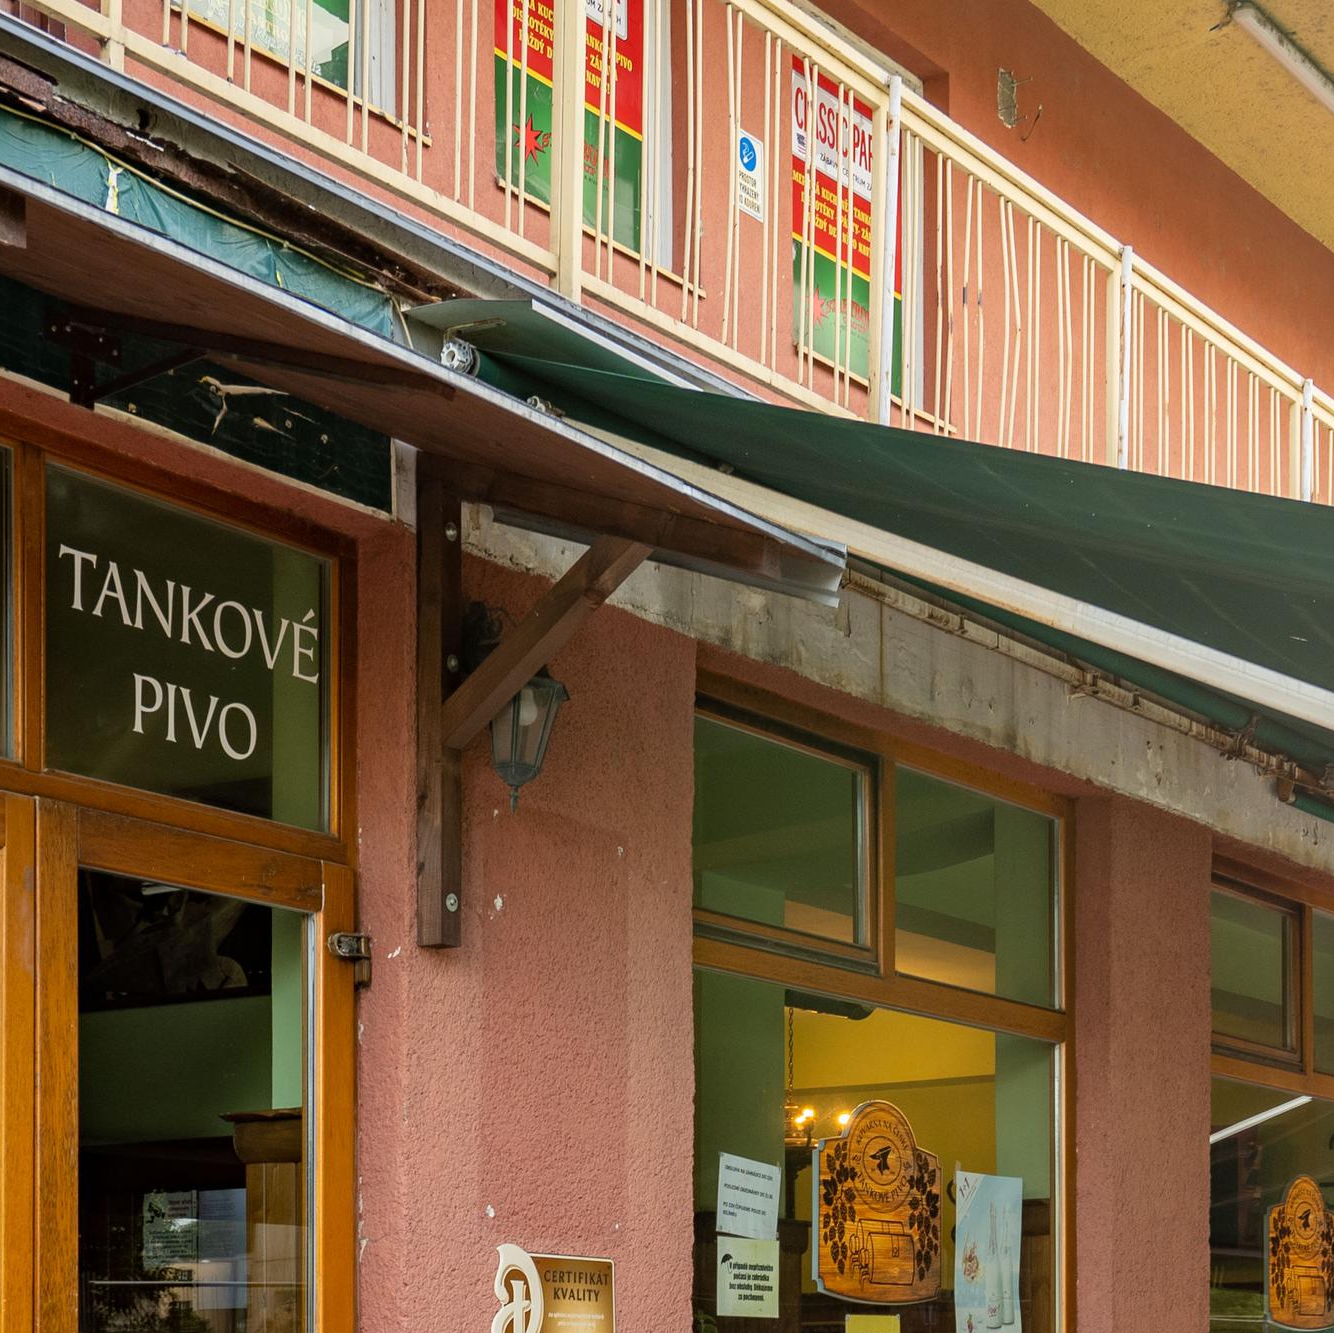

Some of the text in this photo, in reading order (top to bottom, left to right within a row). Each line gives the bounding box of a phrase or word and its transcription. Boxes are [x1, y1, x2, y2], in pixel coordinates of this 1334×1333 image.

[59, 543, 319, 684] TANKOVÉ
[132, 672, 257, 760] PIVO
[553, 1287, 600, 1302] KVALITY
